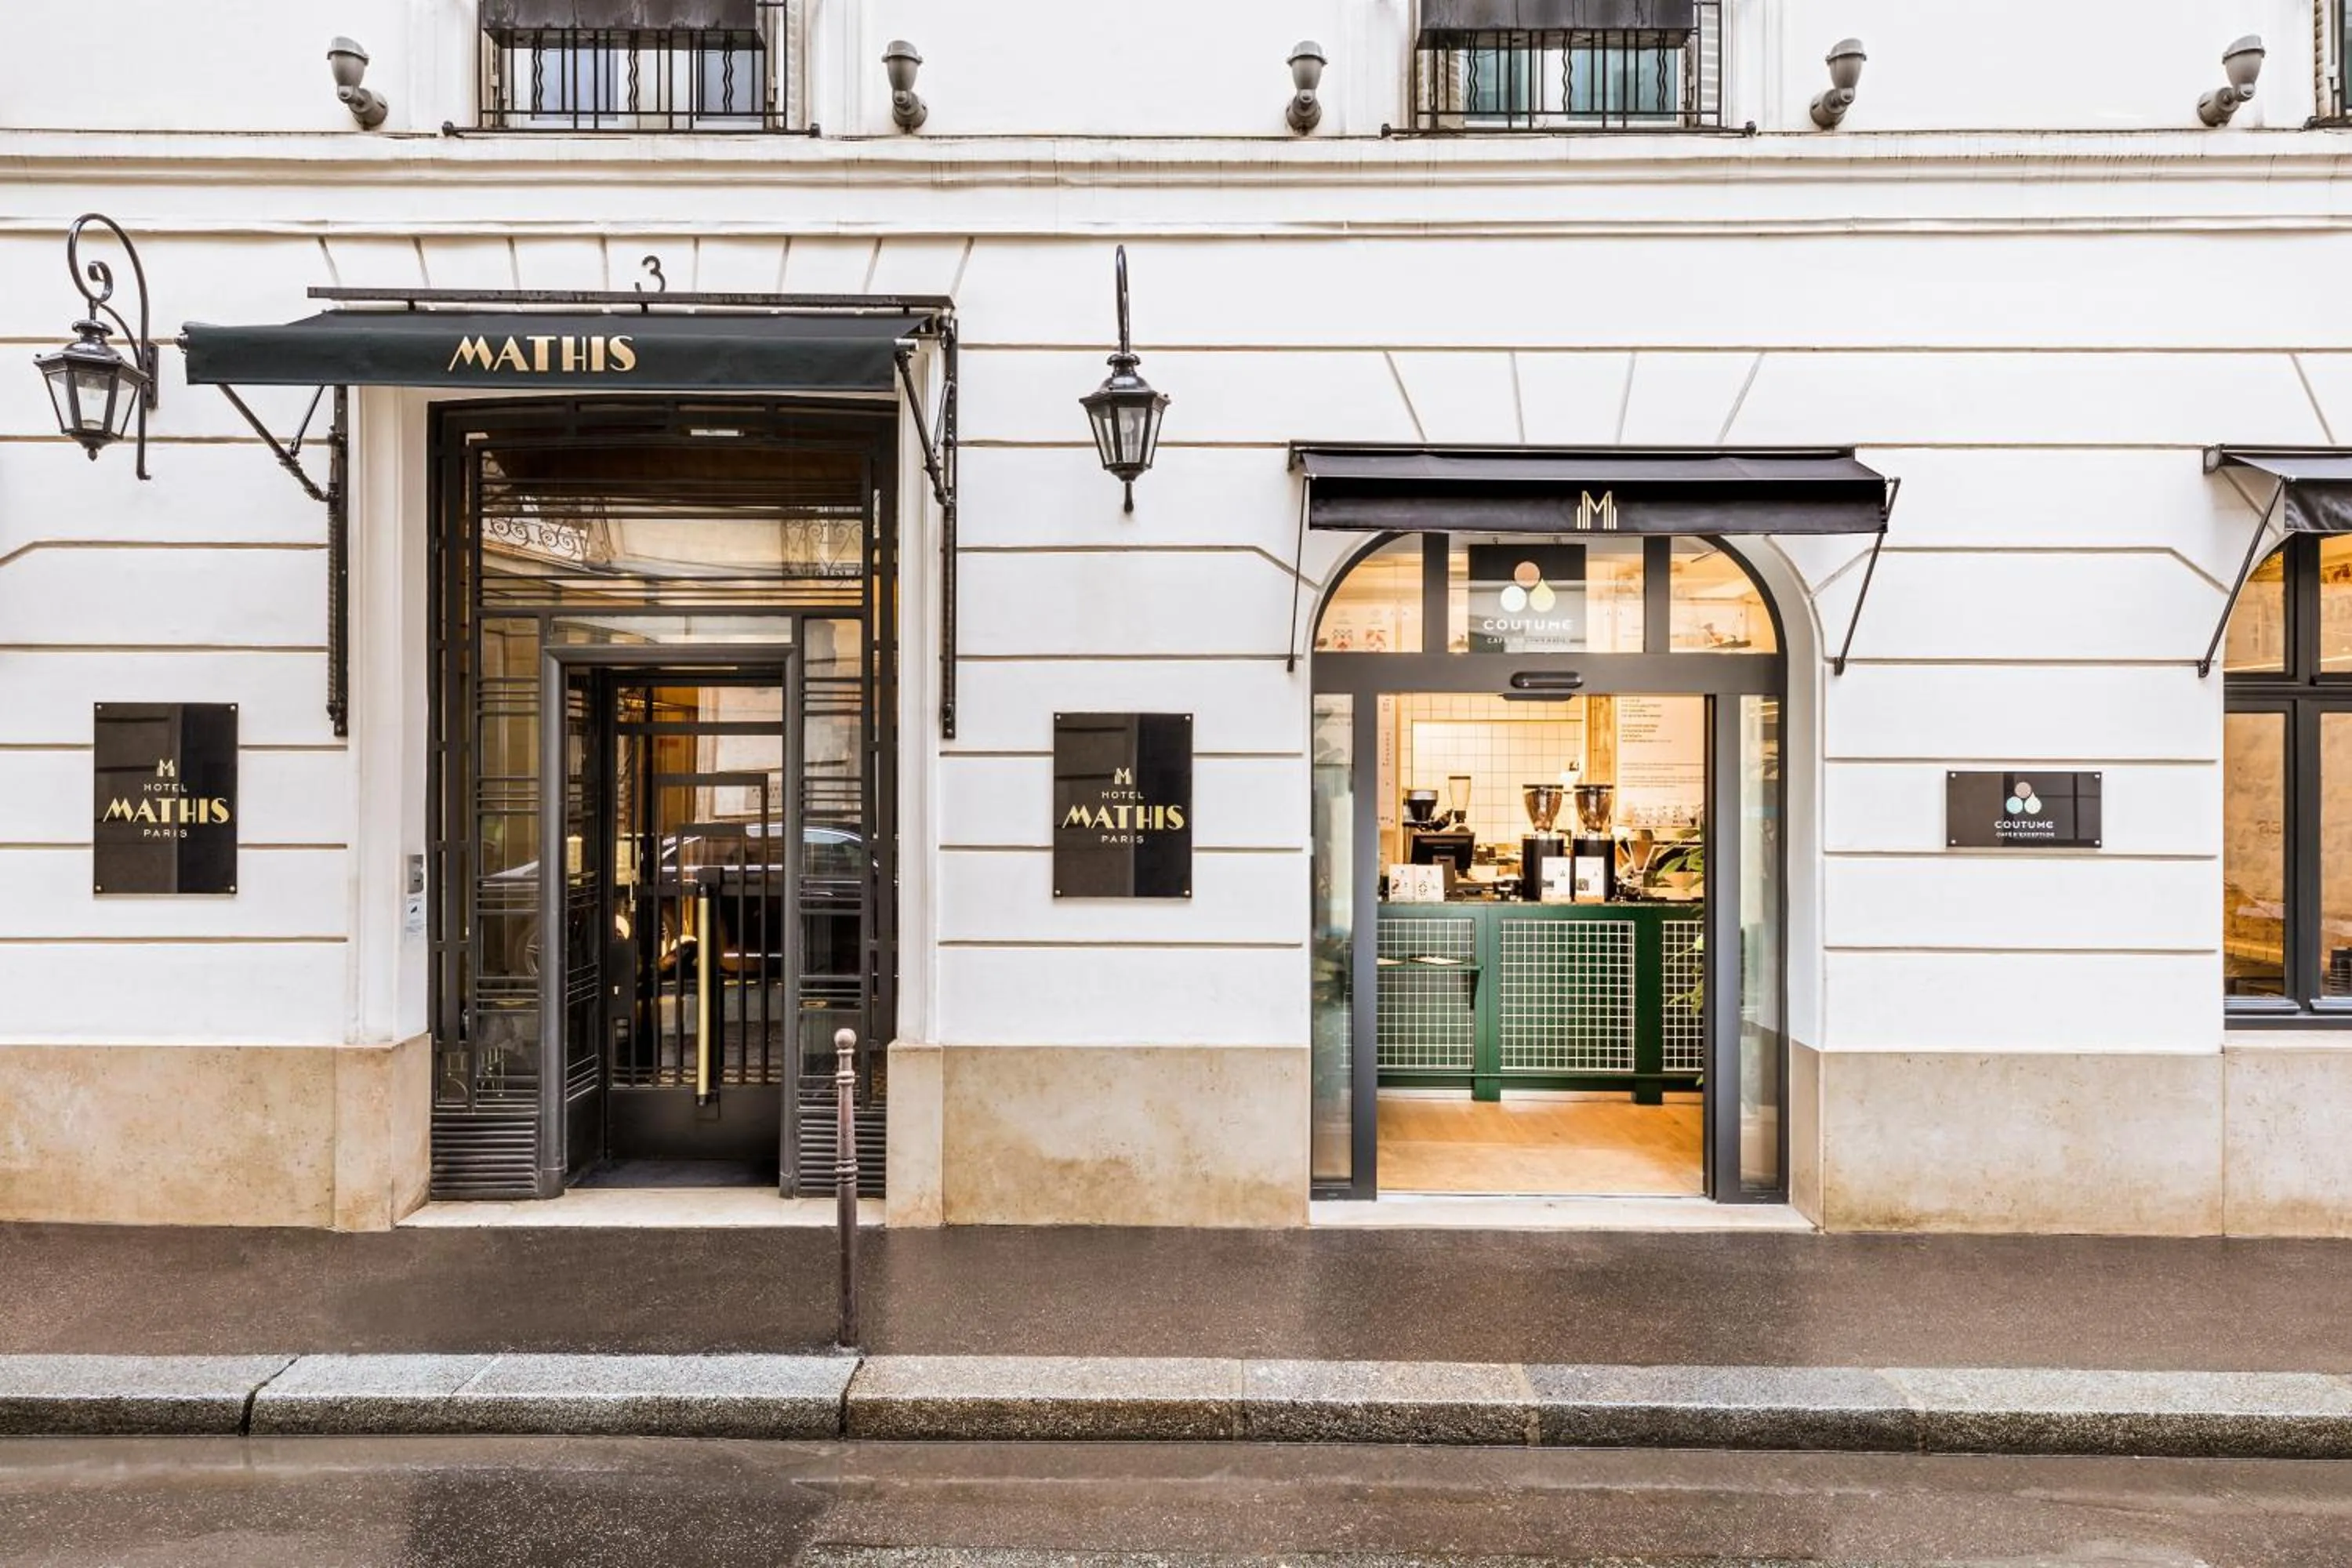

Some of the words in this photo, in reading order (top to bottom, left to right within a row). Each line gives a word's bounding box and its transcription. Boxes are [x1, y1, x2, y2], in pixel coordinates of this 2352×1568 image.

[634, 255, 666, 292] 3
[448, 335, 637, 372] MATHIS
[1577, 490, 1617, 530] M
[1483, 618, 1573, 630] COUTUME
[157, 758, 175, 777] M
[1114, 767, 1133, 785] M
[143, 783, 188, 793] HOTEL
[1102, 790, 1145, 799] HOTEL
[103, 797, 230, 824] MATHIS
[1062, 804, 1185, 830] MATHIS
[143, 829, 188, 838] PARIS
[1994, 820, 2054, 829] COUTUME
[1102, 835, 1145, 844] PARIS
